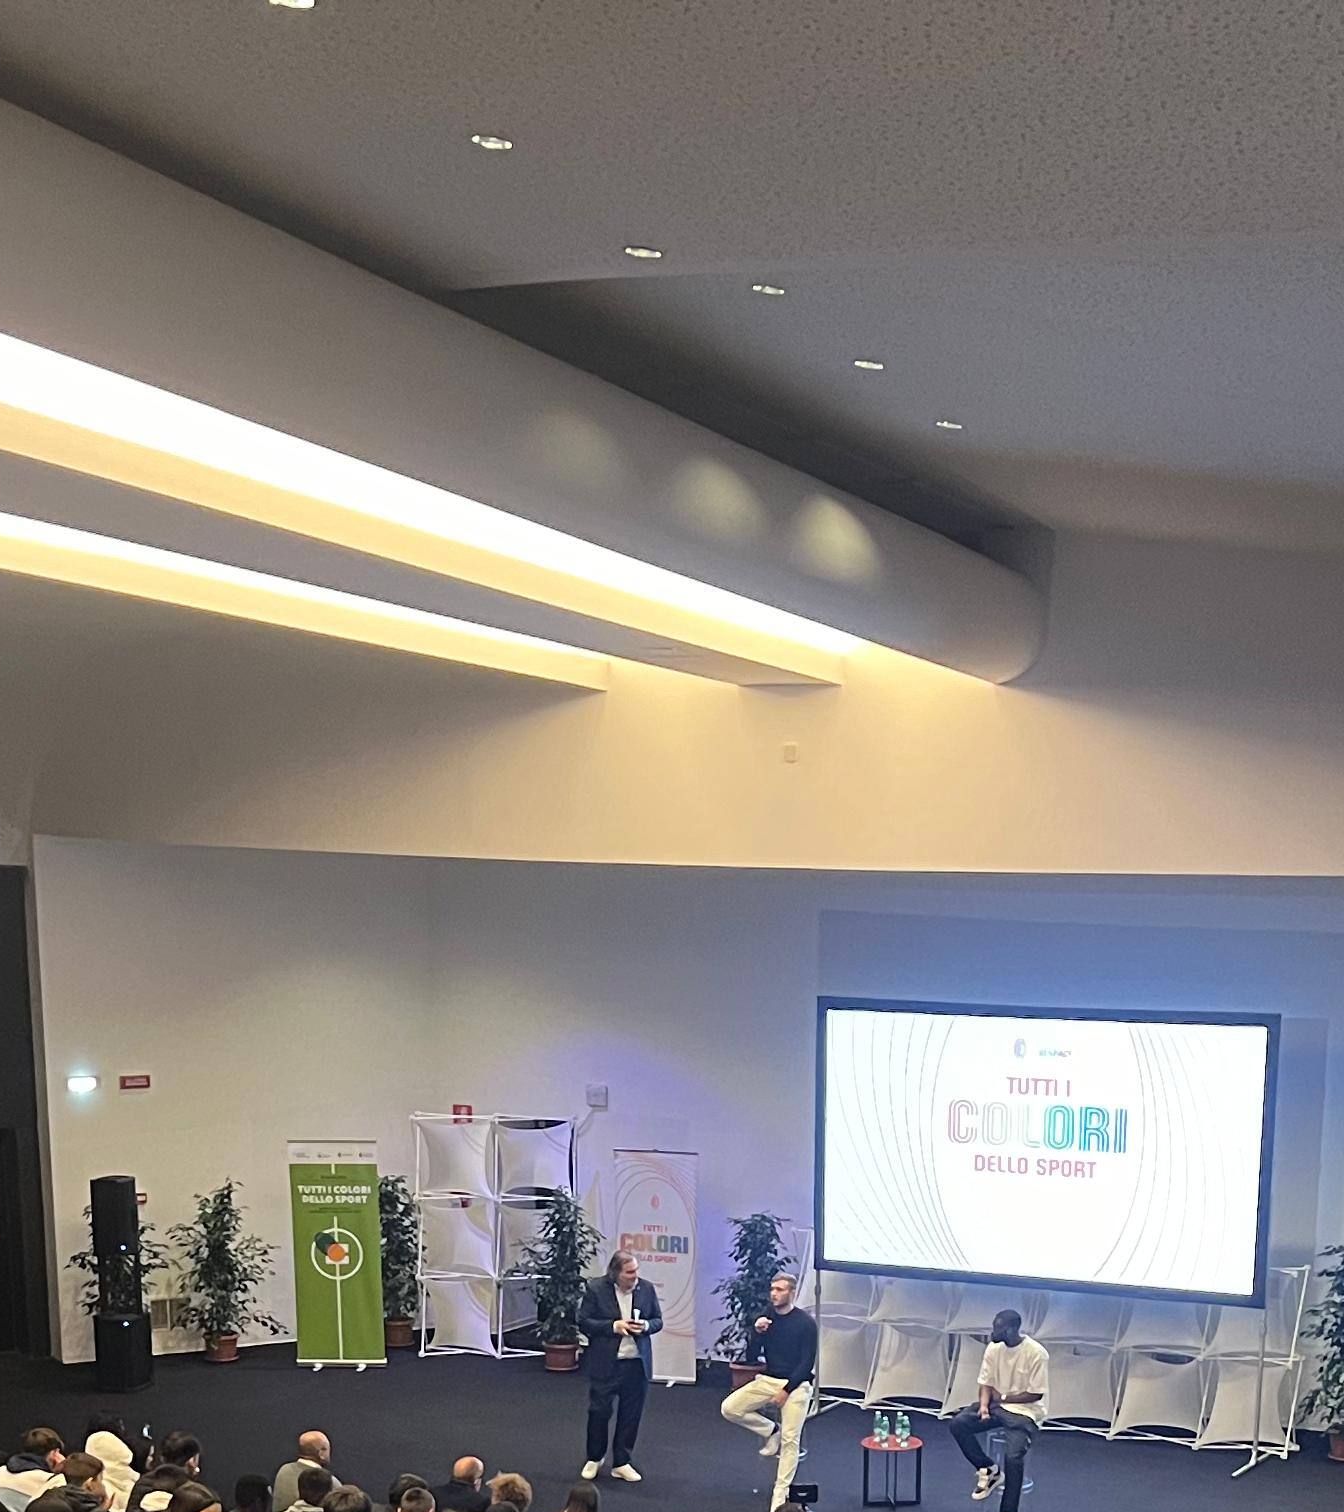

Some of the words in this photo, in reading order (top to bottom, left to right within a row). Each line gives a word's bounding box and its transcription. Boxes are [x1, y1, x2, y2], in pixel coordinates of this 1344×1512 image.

[1006, 1076, 1058, 1096] TUTTI
[1066, 1079, 1071, 1098] I
[947, 1099, 1129, 1154] COLORI
[974, 1154, 1029, 1175] DELLO
[1036, 1158, 1097, 1179] SPORT
[297, 1185, 326, 1194] TUTTI
[333, 1185, 372, 1194] COLORI
[302, 1195, 333, 1204] DELLO
[335, 1195, 368, 1204] SPORT
[620, 1233, 689, 1254] COLORI
